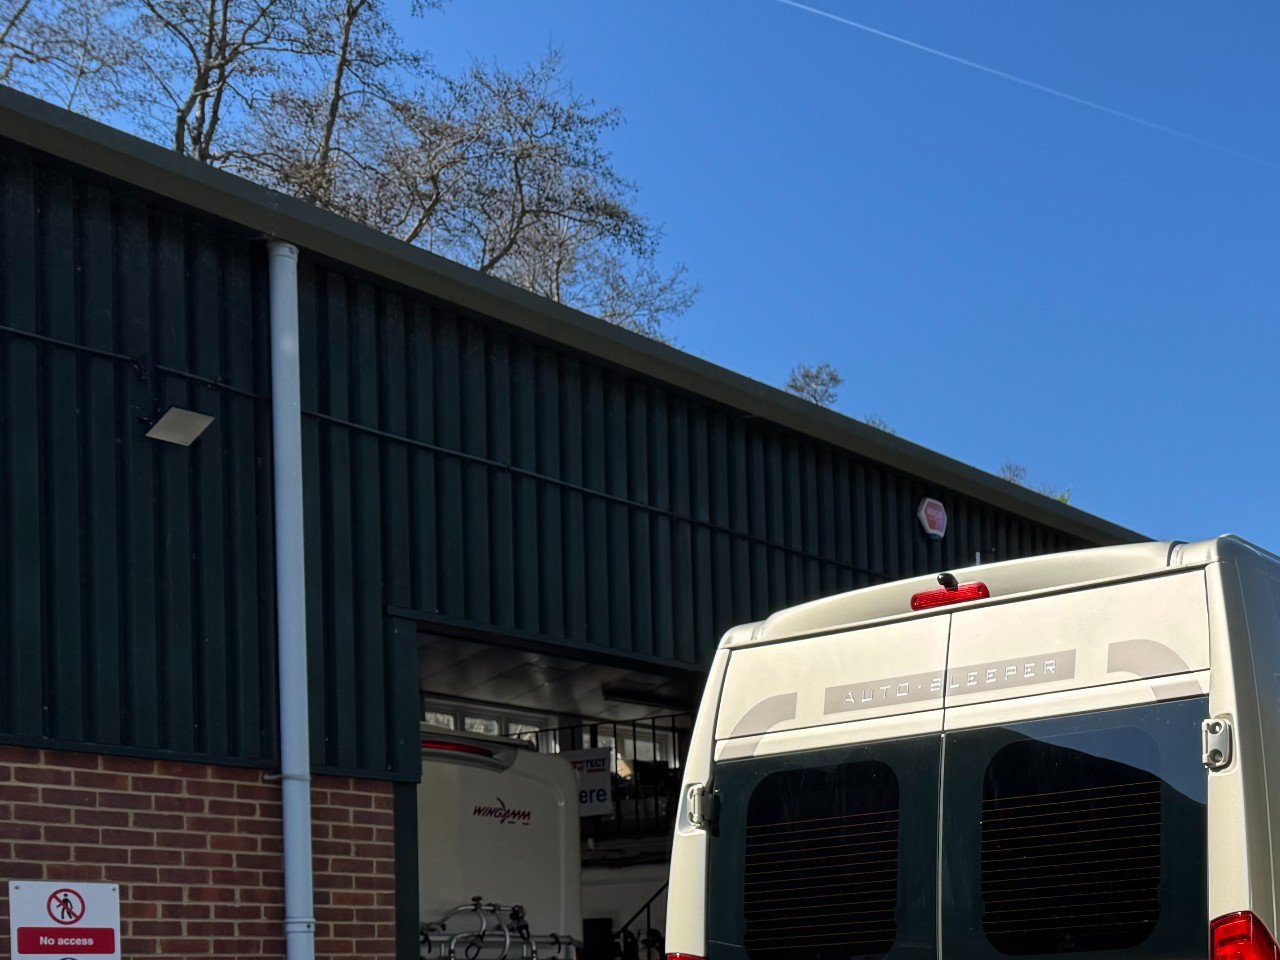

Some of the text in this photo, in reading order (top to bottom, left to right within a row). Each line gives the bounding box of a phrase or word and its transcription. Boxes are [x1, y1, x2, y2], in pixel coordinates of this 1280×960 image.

[473, 801, 531, 823] WINGAMM
[39, 936, 94, 946] No access
